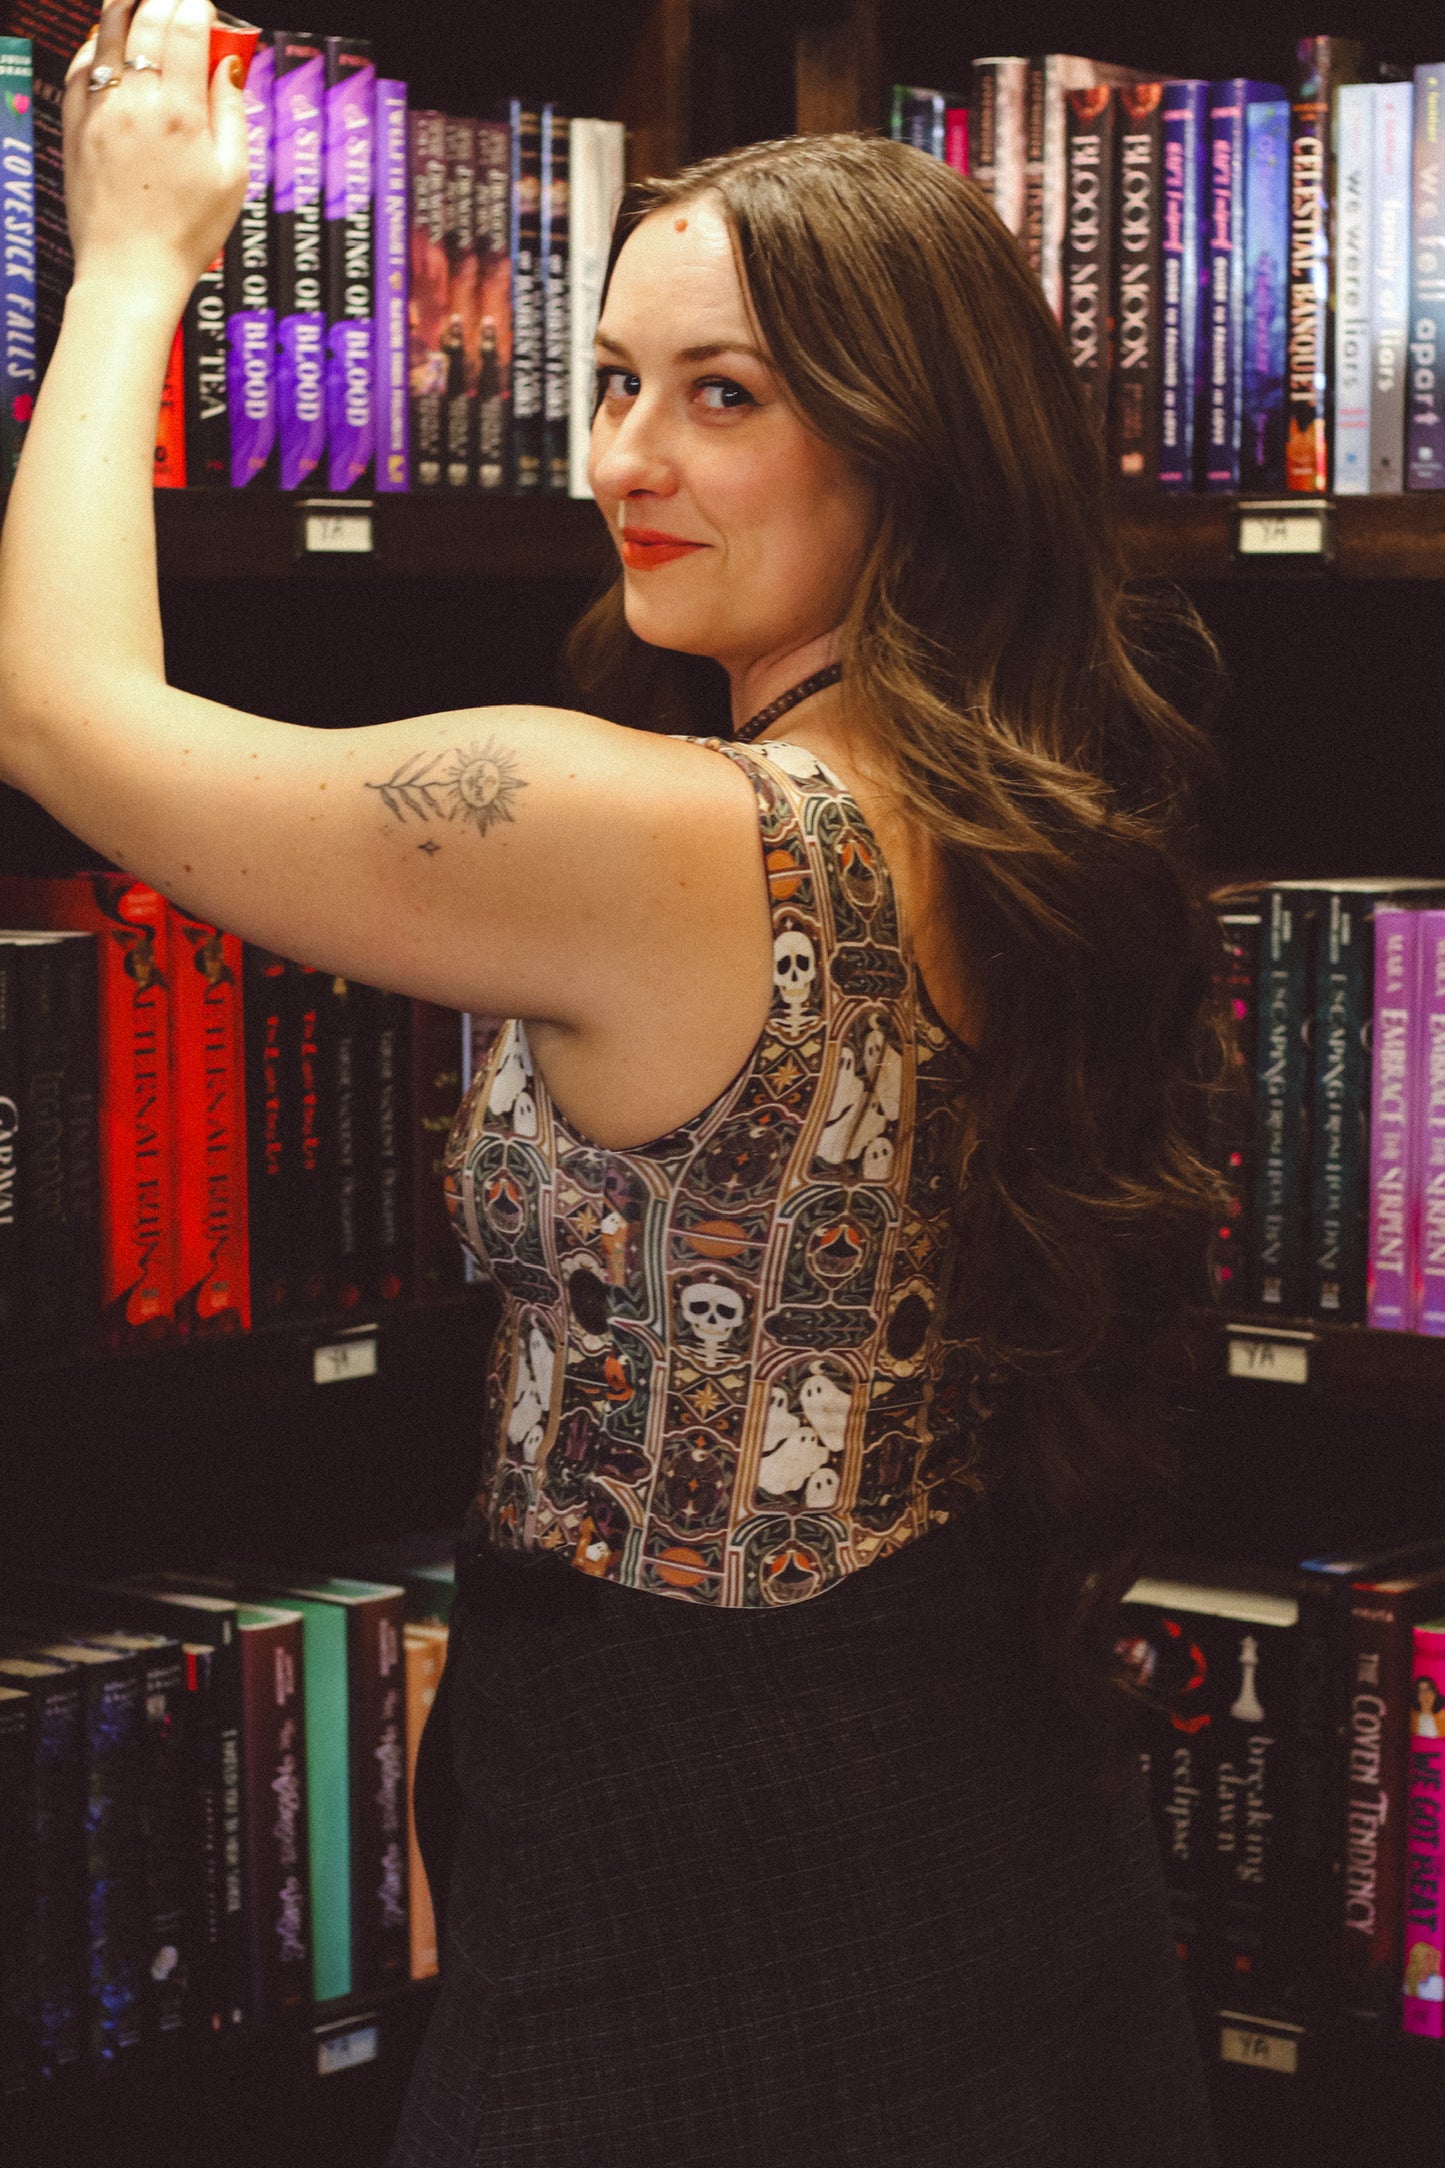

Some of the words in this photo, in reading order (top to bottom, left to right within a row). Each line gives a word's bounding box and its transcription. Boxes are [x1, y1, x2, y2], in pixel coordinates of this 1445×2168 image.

[3, 137, 35, 282] LOVESICK
[294, 127, 320, 272] STEEPING
[344, 136, 370, 279] STEEPING
[1070, 134, 1101, 253] BLOOD
[1121, 134, 1152, 253] BLOOD
[1292, 137, 1322, 277] CELESTIAL
[1346, 171, 1364, 213] we
[1418, 160, 1441, 220] we
[243, 274, 269, 315] OF
[295, 278, 321, 319] OF
[344, 284, 370, 325] OF
[1345, 224, 1362, 307] were
[1416, 235, 1445, 303] fell
[5, 293, 36, 382] FALLS
[198, 296, 225, 341] OF
[1070, 263, 1100, 368] MOON
[1119, 263, 1150, 369] MOON
[1290, 284, 1318, 407] BANQUET
[1344, 318, 1370, 391] liars
[1378, 328, 1405, 392] liars
[199, 349, 227, 420] TEA
[244, 321, 269, 420] BLOOD
[295, 324, 321, 422] BLOOD
[345, 331, 370, 427] BLOOD
[1410, 318, 1441, 427] apart
[1350, 1694, 1387, 1785] COVEN
[1164, 1749, 1200, 1860] eclipse
[1236, 1736, 1275, 1883] breaking
[1346, 1790, 1389, 1935] TENDENCY
